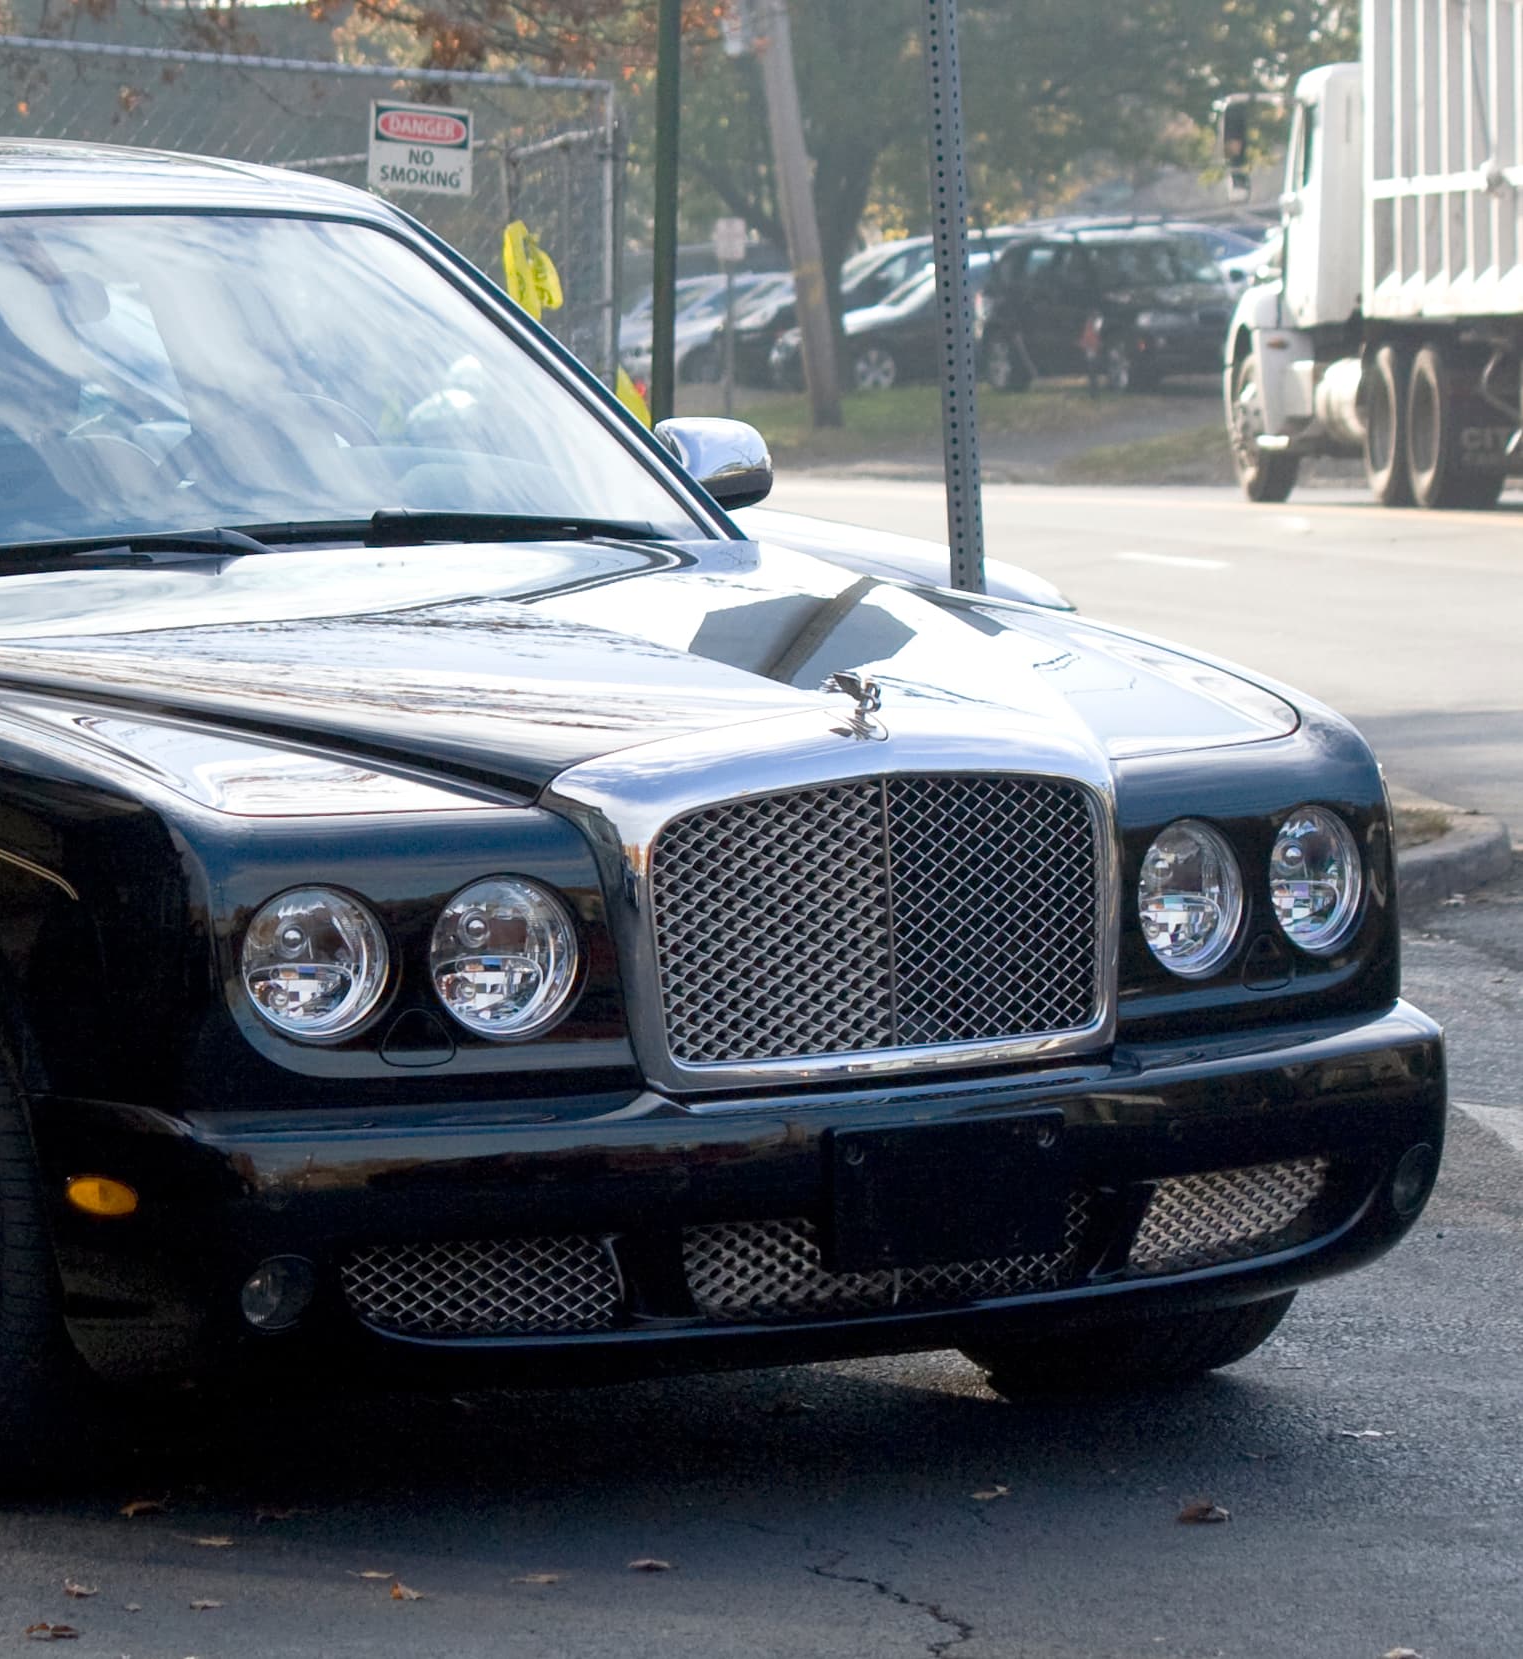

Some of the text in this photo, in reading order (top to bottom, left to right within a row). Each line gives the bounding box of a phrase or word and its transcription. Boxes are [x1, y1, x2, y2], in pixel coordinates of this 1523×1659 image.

[389, 114, 455, 138] DANGER
[409, 149, 434, 167] NO
[380, 165, 461, 189] SMOKING
